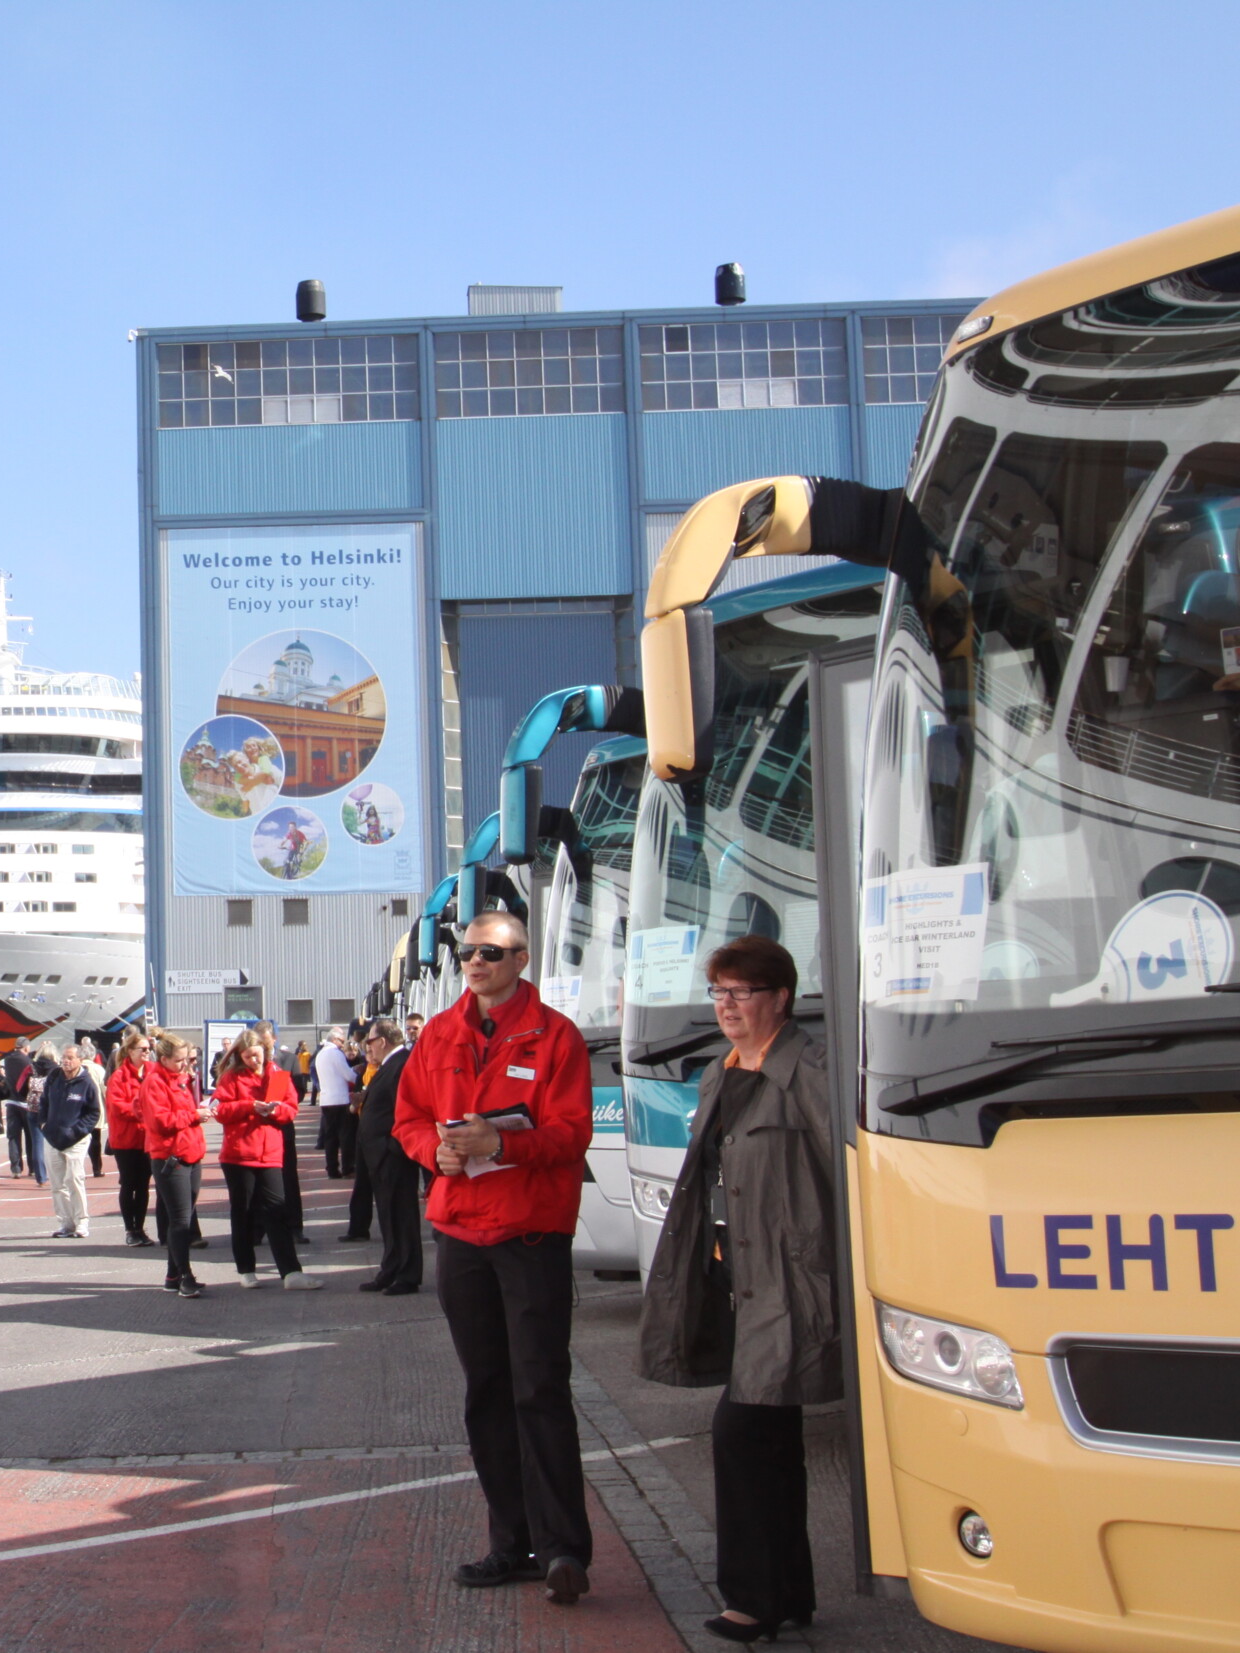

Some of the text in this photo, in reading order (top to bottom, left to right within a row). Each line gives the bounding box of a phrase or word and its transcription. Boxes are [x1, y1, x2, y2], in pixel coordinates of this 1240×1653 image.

[183, 548, 402, 568] Welcome to Helsinki!
[210, 573, 375, 591] Our city is your city.
[228, 596, 359, 613] Enjoy your stay!
[905, 919, 962, 930] HIGHLIGHTS &
[891, 931, 976, 944] ICE BAR WINTERLAND
[918, 945, 941, 954] VISIT
[873, 953, 883, 978] 3
[1137, 938, 1187, 990] 3
[989, 1213, 1235, 1293] LEHT
